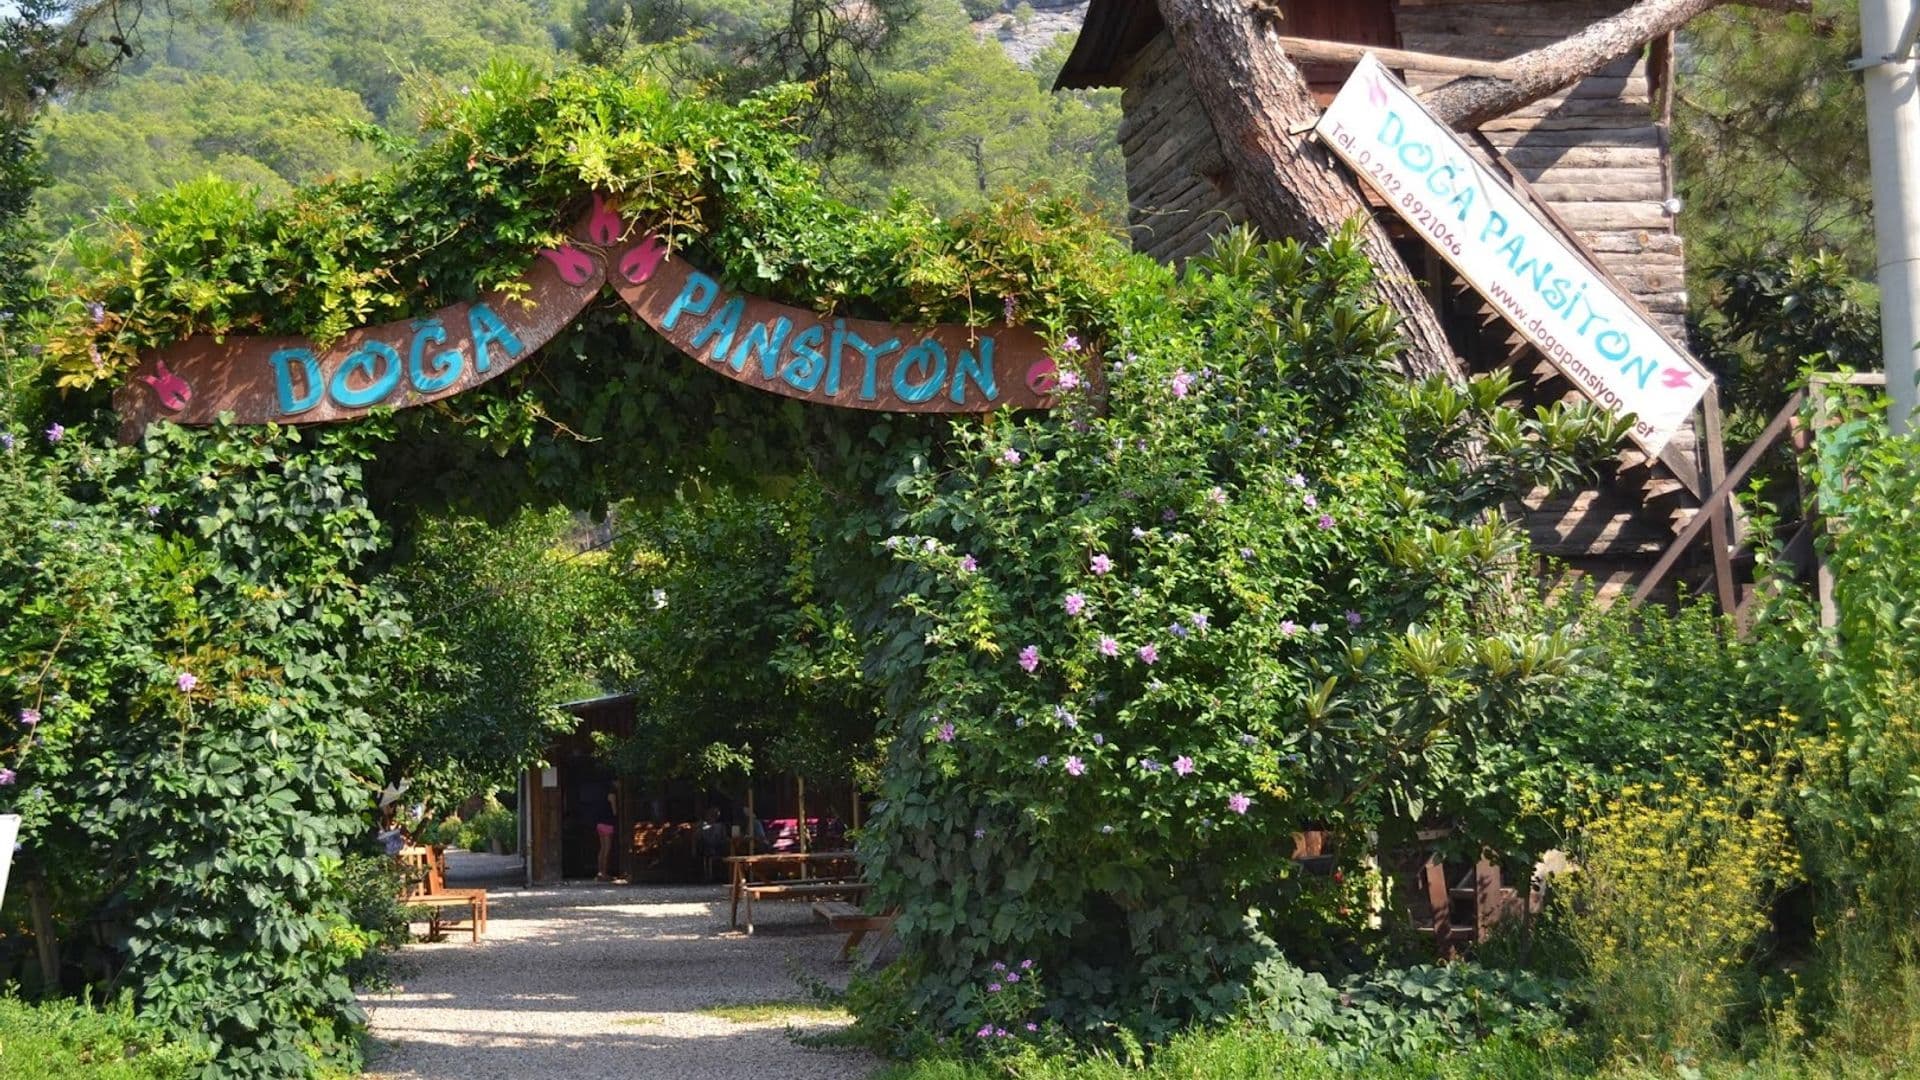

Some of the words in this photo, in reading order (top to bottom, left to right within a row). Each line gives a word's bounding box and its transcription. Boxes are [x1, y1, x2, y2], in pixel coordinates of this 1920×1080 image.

[1377, 111, 1475, 221] DOĞA
[1402, 193, 1461, 255] 8921066
[268, 302, 526, 416] DOĞA
[1490, 280, 1655, 438] www.dogapansiyonet
